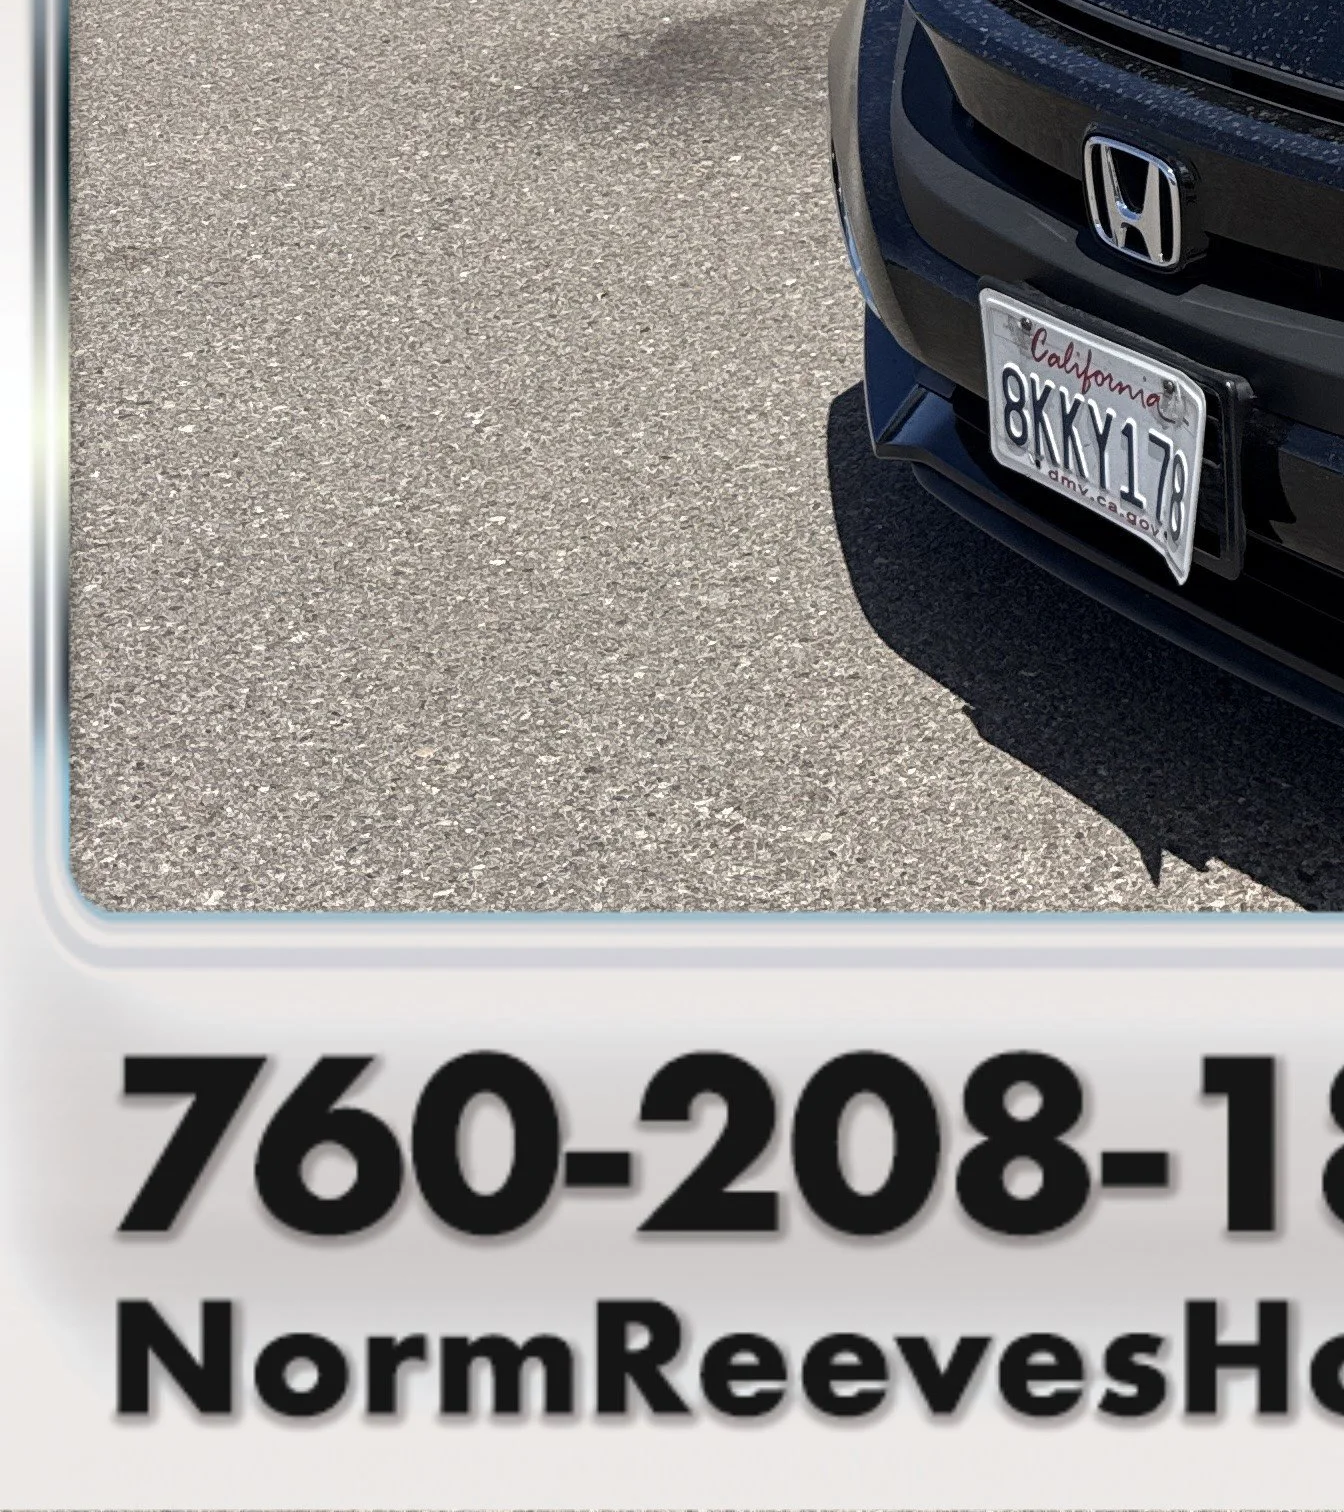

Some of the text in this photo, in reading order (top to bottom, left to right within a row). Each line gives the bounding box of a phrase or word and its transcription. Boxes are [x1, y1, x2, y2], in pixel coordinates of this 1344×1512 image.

[1031, 327, 1160, 409] California
[1002, 362, 1189, 544] 8KKY178
[1047, 467, 1161, 543] dmv.ca.gov
